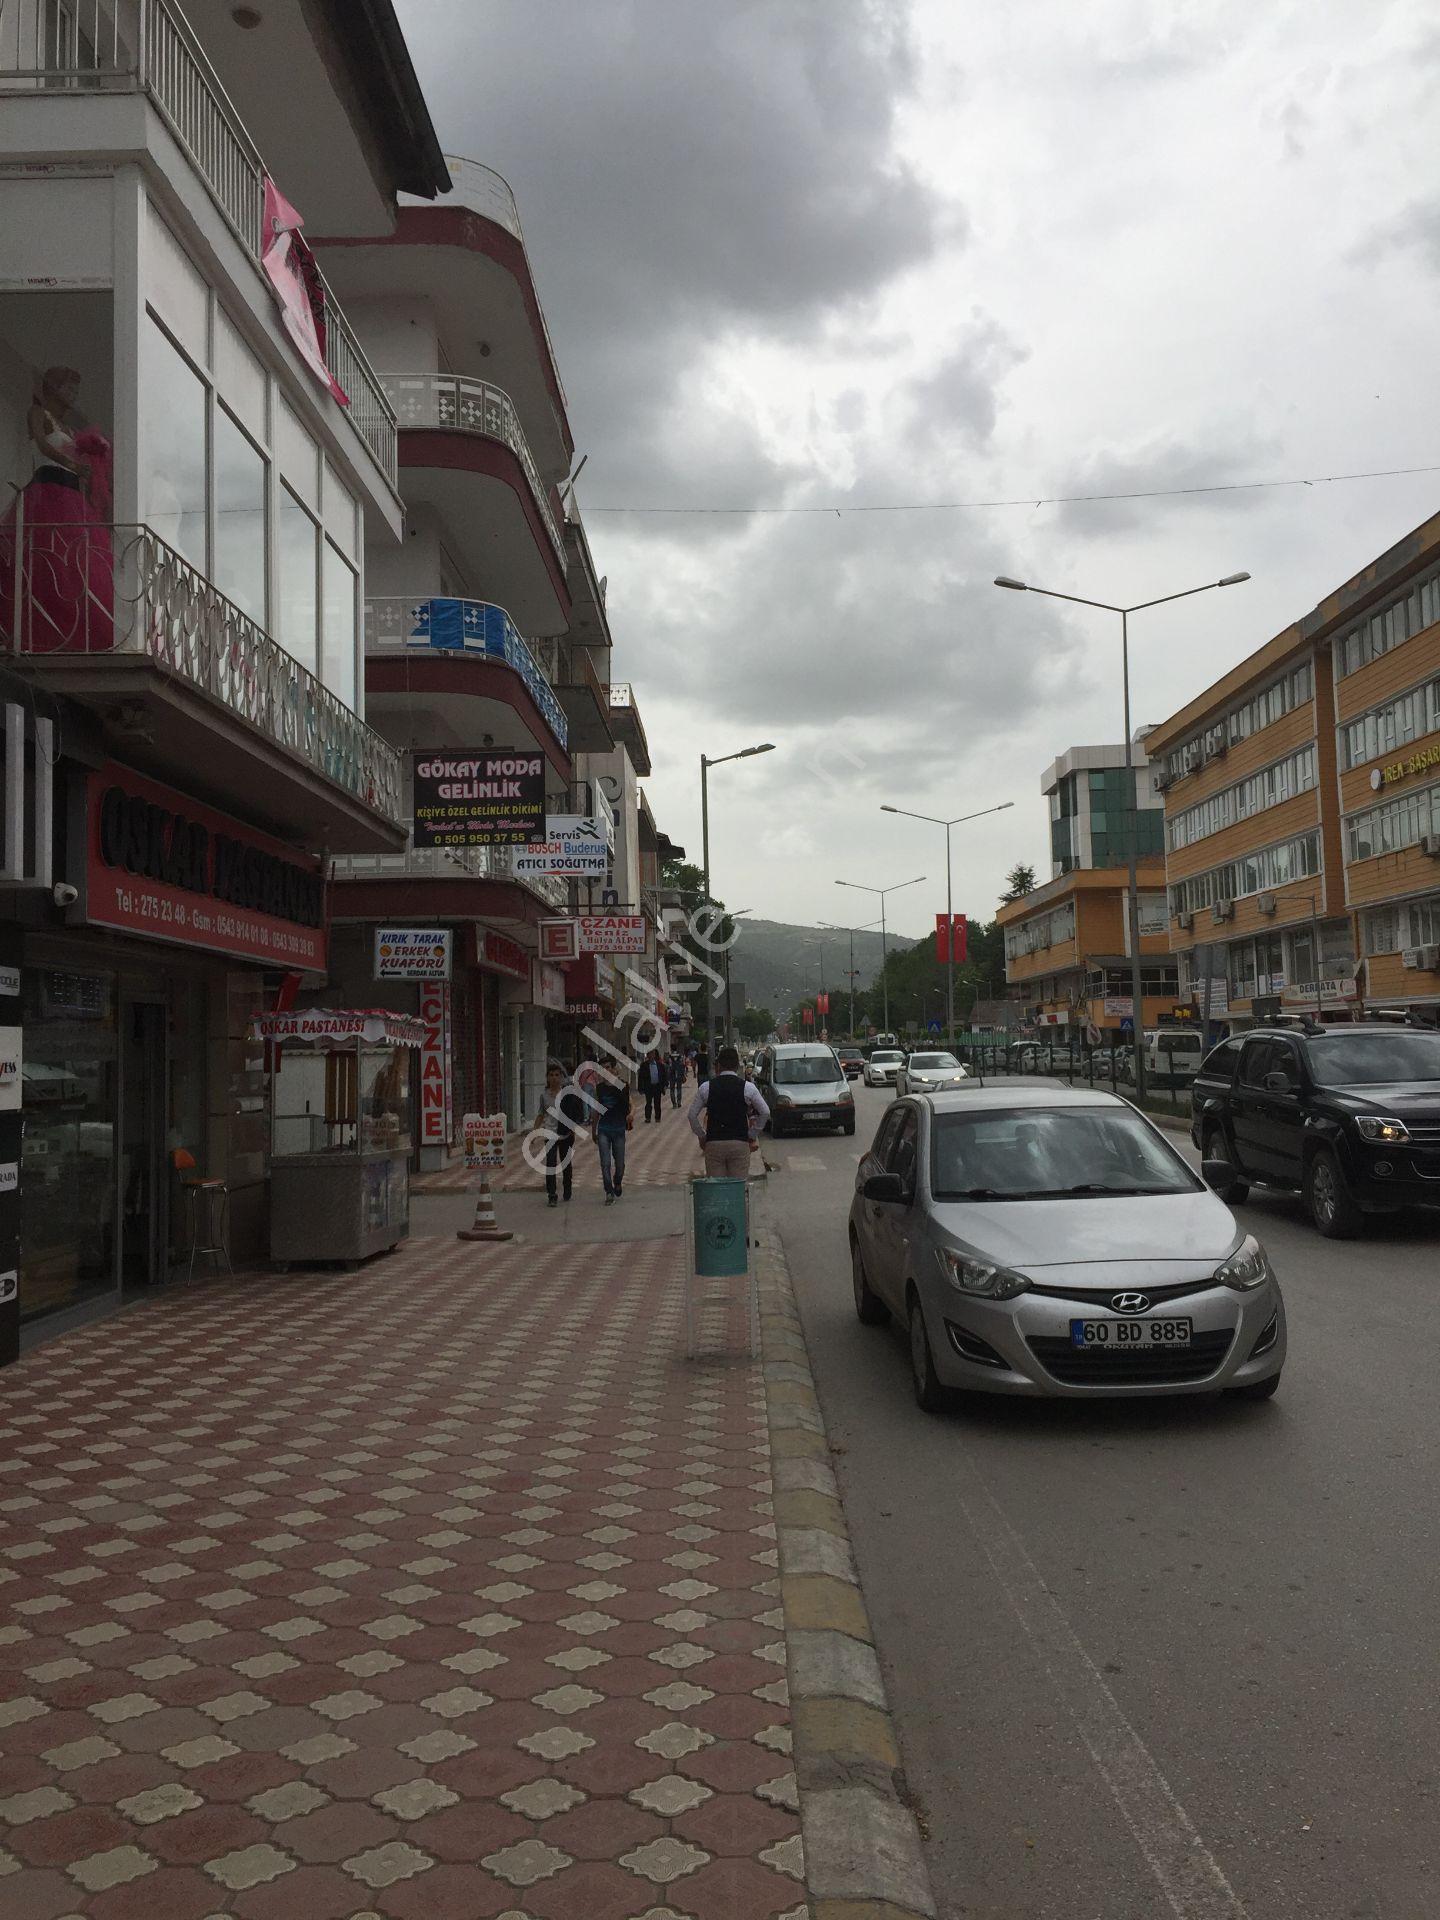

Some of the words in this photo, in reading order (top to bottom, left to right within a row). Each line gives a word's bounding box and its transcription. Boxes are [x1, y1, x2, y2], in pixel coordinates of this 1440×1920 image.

[417, 757, 481, 778] GÖKAY
[487, 760, 541, 776] MODA
[438, 779, 521, 799] GELİNLİK
[417, 806, 445, 819] KİŞİYE
[448, 806, 470, 816] ÖZEL
[471, 803, 510, 816] GELİNLİK
[512, 802, 542, 814] DİKİMİ
[434, 835, 441, 844] 0
[444, 835, 465, 844] 505
[469, 834, 490, 843] 950
[494, 834, 507, 842] 37
[511, 833, 526, 842] 55
[549, 830, 581, 840] Servis
[528, 842, 561, 854] BOSCH
[564, 842, 606, 854] Buderus
[517, 859, 546, 869] ATICI
[550, 857, 605, 869] SOĞUTMA
[115, 887, 132, 913] Tel
[140, 894, 158, 918] 275
[160, 900, 172, 922] 23
[174, 903, 186, 925] 48
[192, 909, 210, 930] Gsm
[217, 914, 235, 937] 0543
[236, 920, 250, 941] 914
[580, 918, 642, 929] CZANE
[380, 934, 408, 944] KIRIK
[413, 934, 445, 944] TARAK
[394, 946, 431, 956] ERKEK
[380, 957, 445, 968] KUAFÖRÜ
[260, 1020, 297, 1035] OSKAR
[301, 1019, 365, 1033] PASTANESİ
[1084, 1323, 1108, 1342] 60
[1117, 1323, 1142, 1342] BD
[1150, 1321, 1188, 1342] 885
